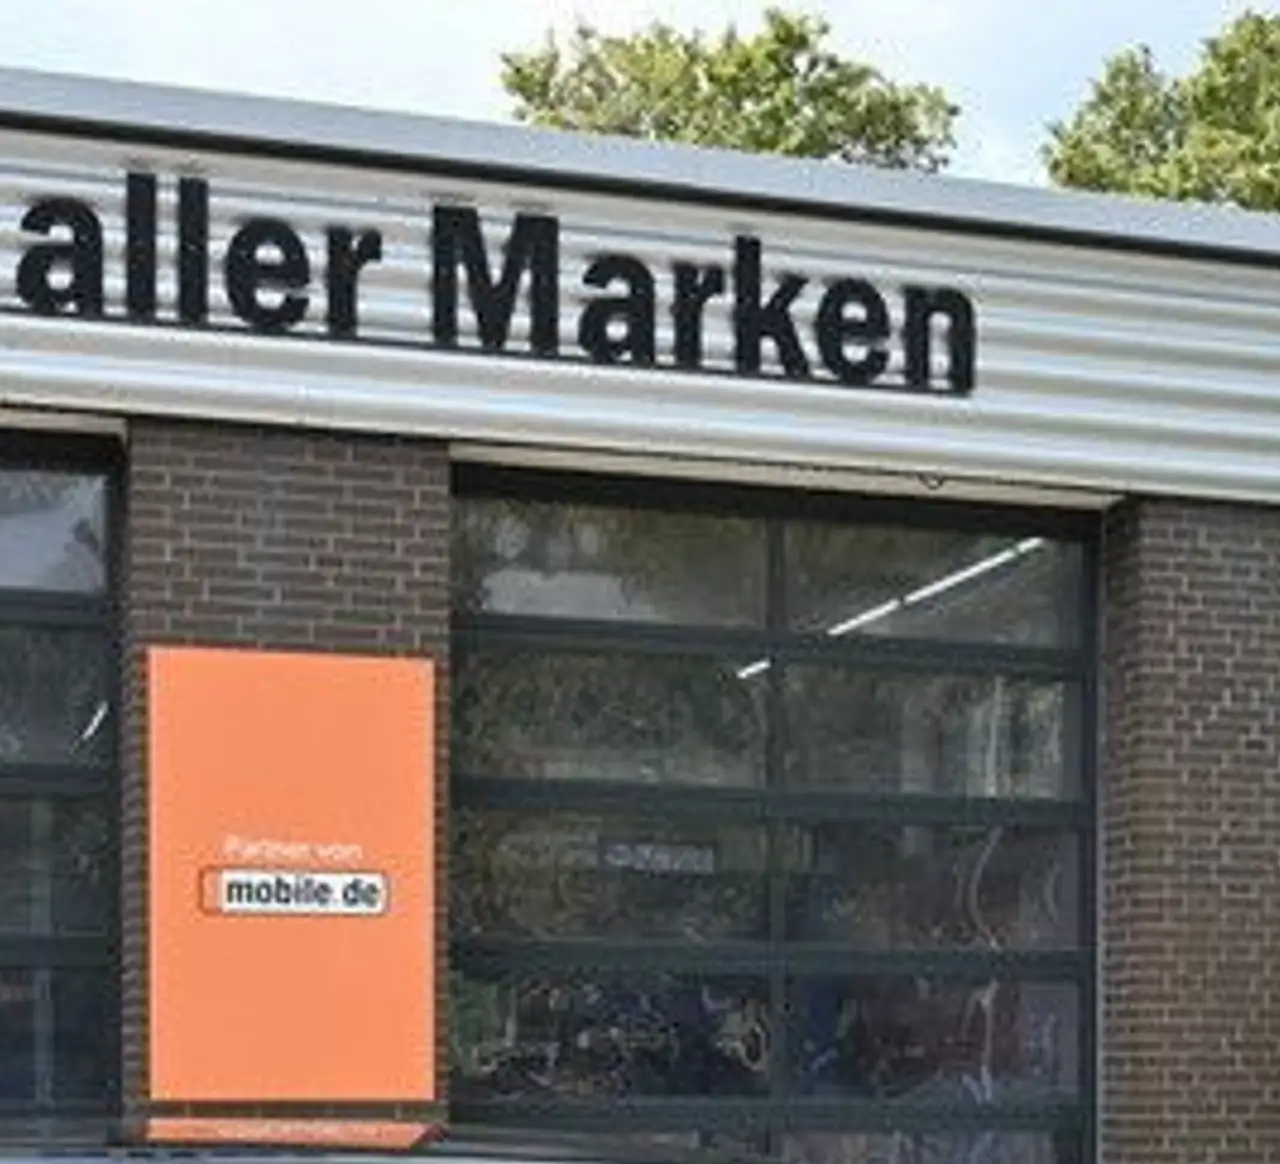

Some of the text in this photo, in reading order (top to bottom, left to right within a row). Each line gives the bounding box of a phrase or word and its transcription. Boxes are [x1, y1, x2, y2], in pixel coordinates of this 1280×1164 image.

[16, 172, 382, 338] aller
[430, 205, 978, 395] Marken
[226, 876, 378, 907] mobile.de
